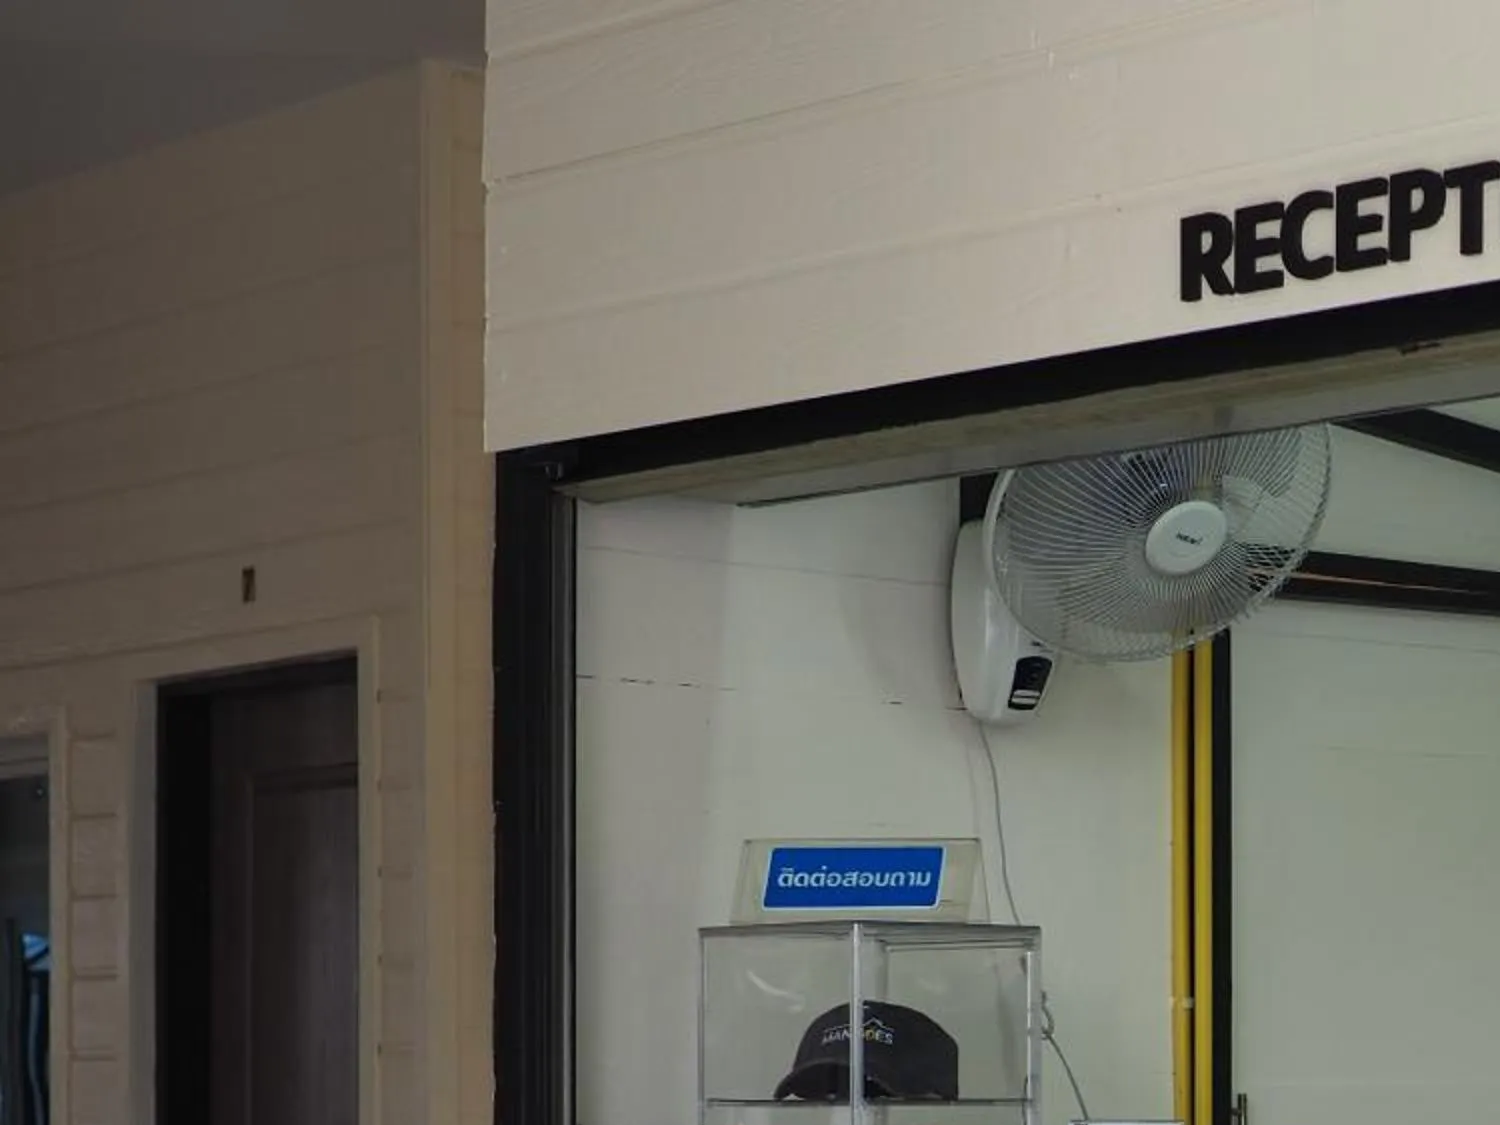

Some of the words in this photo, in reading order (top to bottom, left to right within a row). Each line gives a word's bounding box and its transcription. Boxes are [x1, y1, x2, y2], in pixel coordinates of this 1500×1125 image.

[776, 864, 932, 888] ติดต่อสอบถาม
